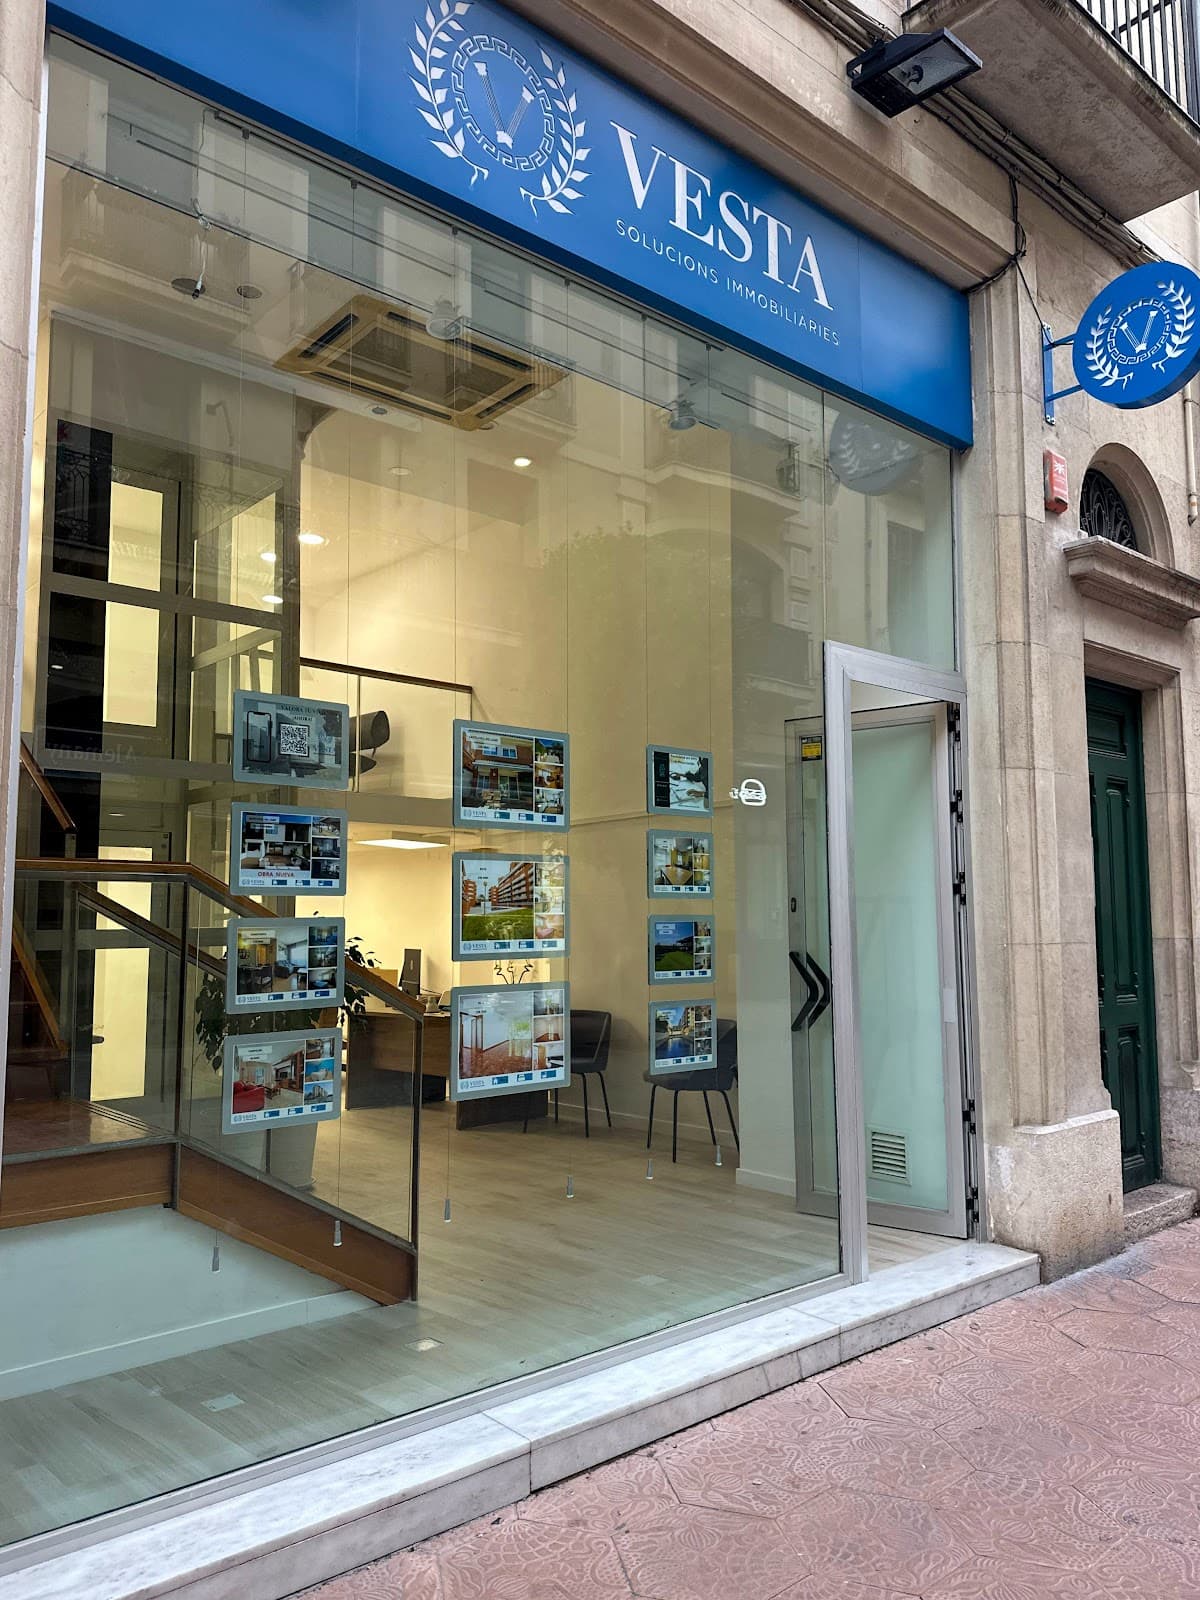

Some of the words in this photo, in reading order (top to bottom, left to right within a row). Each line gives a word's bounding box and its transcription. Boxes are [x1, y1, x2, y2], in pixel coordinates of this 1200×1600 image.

[610, 120, 834, 312] VESTA
[615, 218, 719, 284] SOLUCIONS
[727, 276, 840, 347] IMMOBILIARIES
